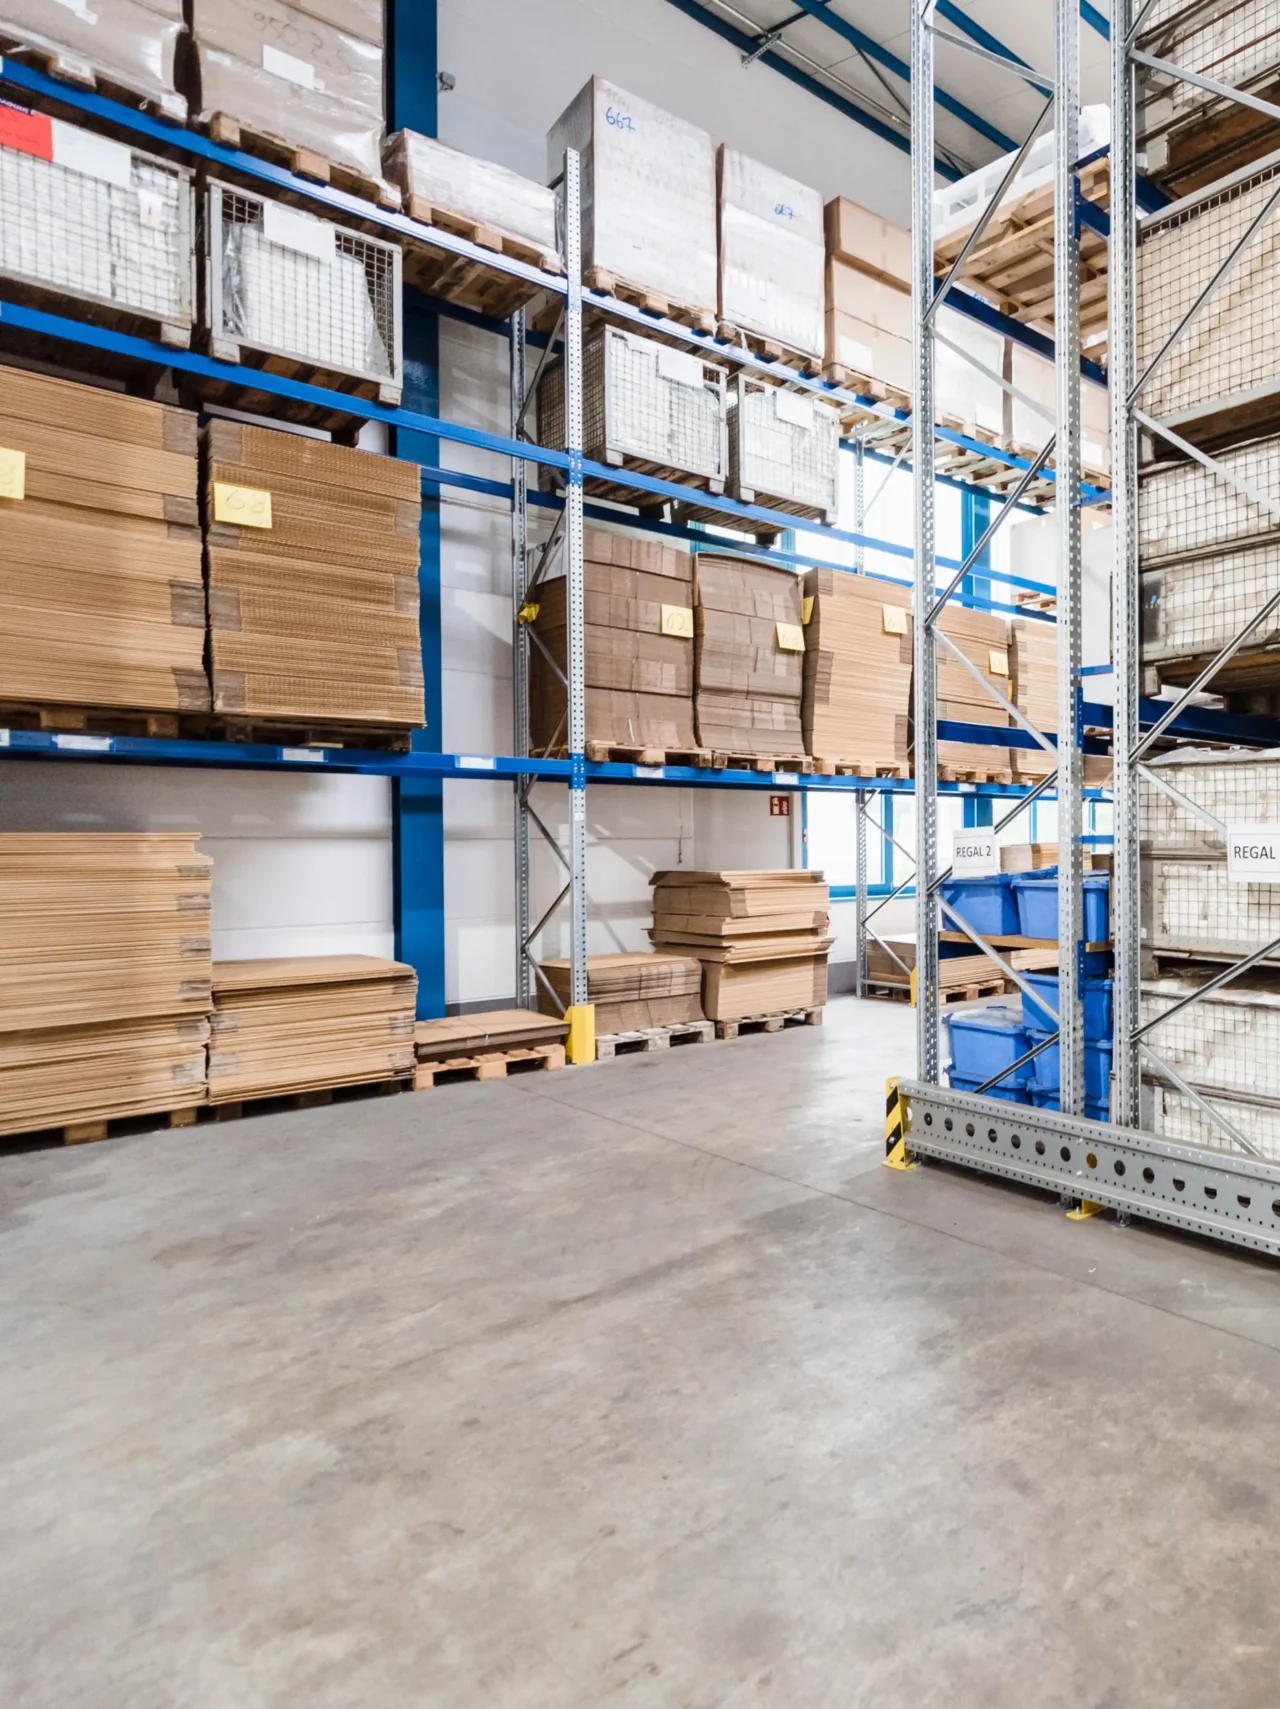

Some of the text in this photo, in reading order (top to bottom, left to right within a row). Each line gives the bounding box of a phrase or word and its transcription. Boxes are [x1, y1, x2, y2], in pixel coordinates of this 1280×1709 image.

[605, 106, 636, 133] 667
[956, 845, 992, 858] REGAL 2
[1234, 845, 1276, 860] REGAL
